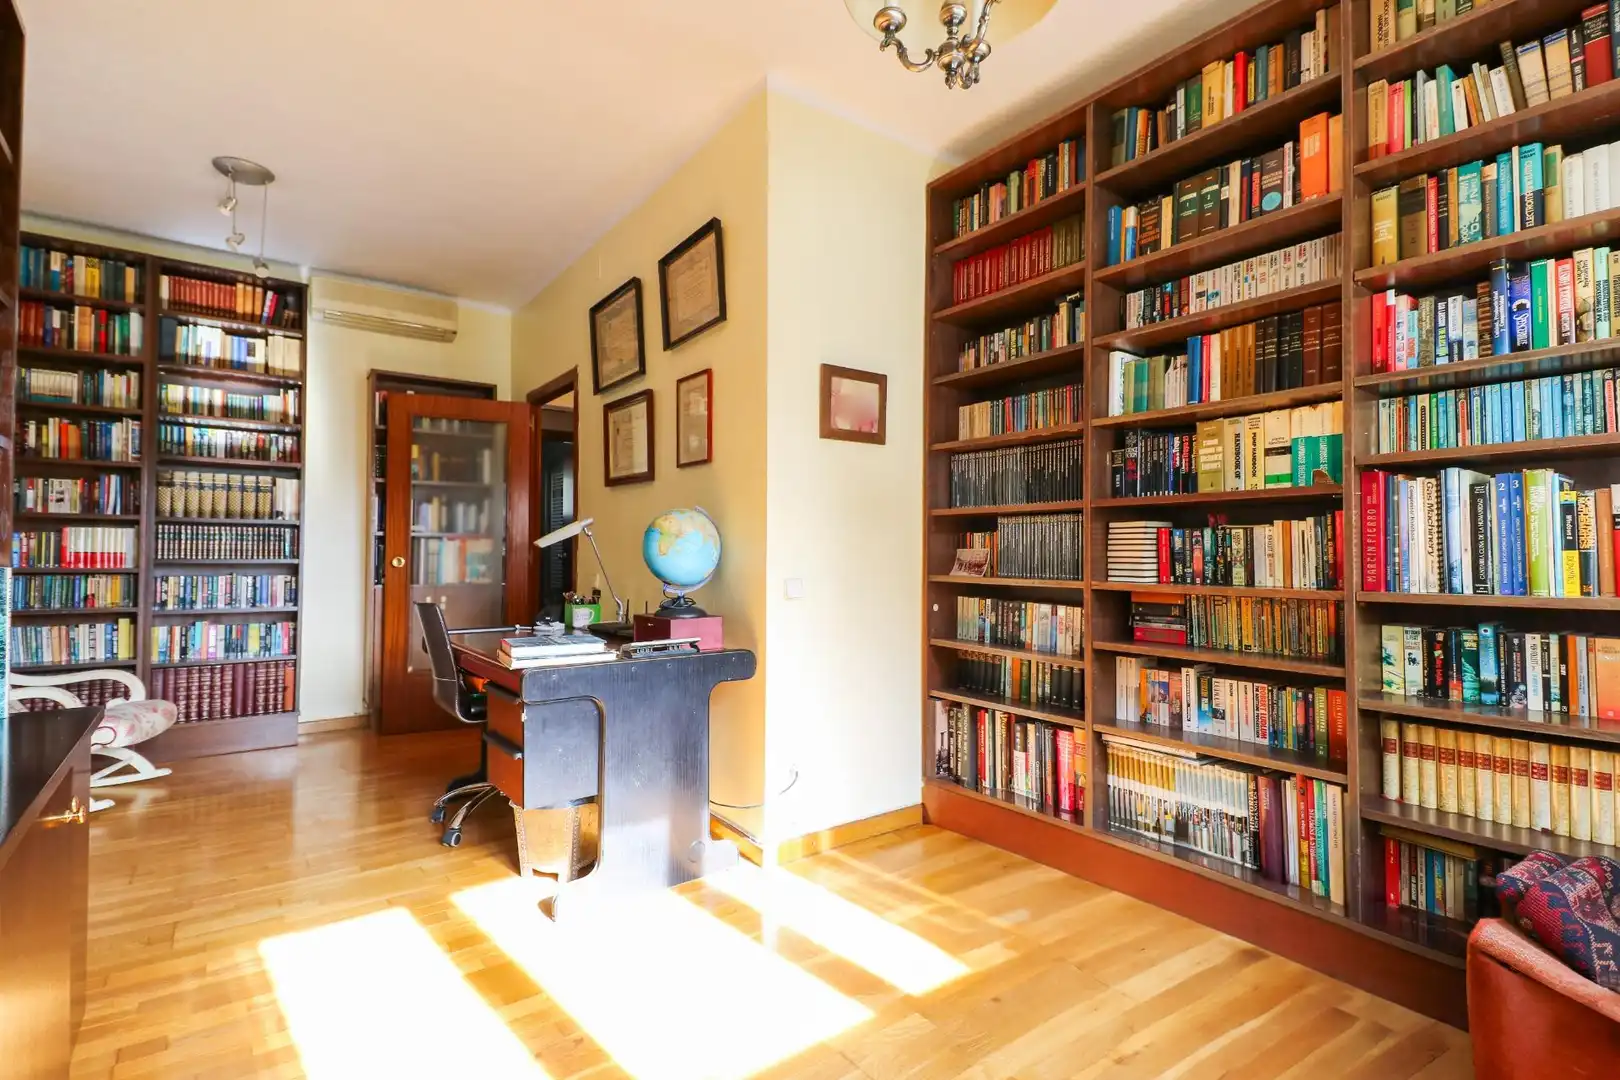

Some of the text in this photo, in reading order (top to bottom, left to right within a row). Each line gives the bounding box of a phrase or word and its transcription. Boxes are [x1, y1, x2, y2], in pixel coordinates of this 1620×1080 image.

[1234, 471, 1241, 479] OF
[1512, 479, 1519, 488] 3
[1499, 482, 1505, 491] 2
[1426, 481, 1436, 558] Gas Machinery
[1565, 514, 1573, 536] Windows
[1578, 495, 1587, 551] MATHEMATICS
[1367, 508, 1377, 583] MARTIN FIERRO
